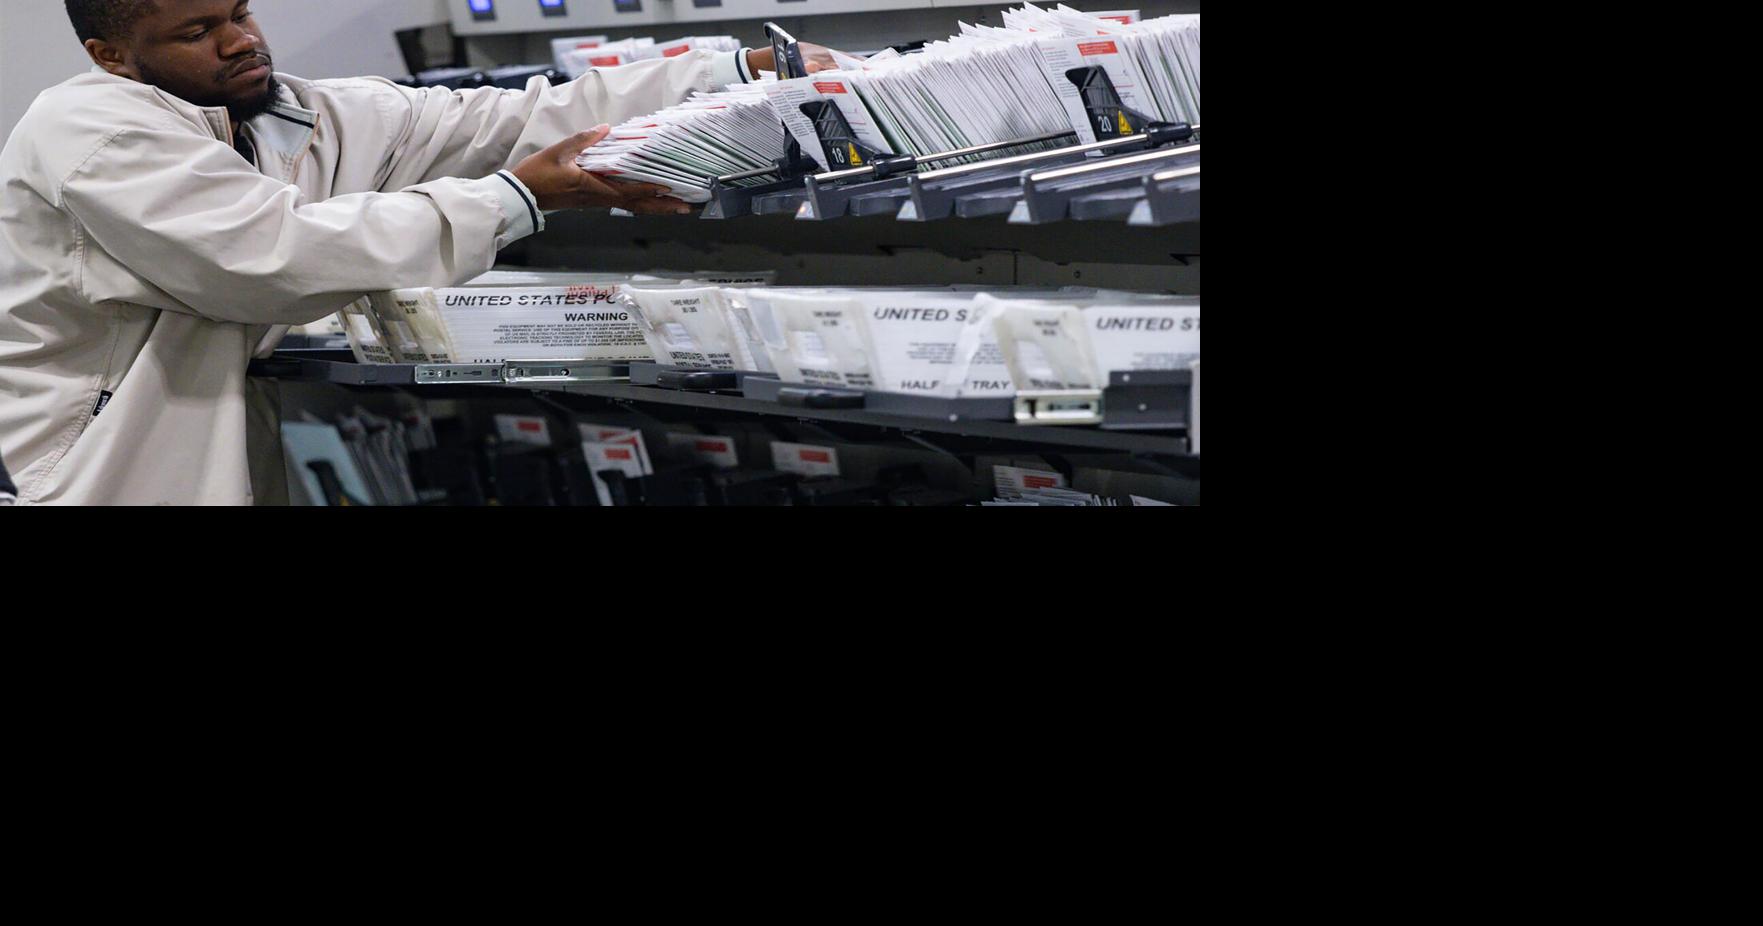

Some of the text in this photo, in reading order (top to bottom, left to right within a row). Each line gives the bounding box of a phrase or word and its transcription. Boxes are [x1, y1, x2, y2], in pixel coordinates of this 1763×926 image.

[1098, 116, 1112, 132] 20
[832, 147, 845, 164] 18
[445, 295, 512, 306] UNITED
[518, 294, 588, 306] STATES
[564, 312, 628, 321] WARNING
[874, 307, 949, 321] UNITED
[1096, 317, 1174, 331] UNITED
[900, 380, 1011, 390] HALF TRAY
